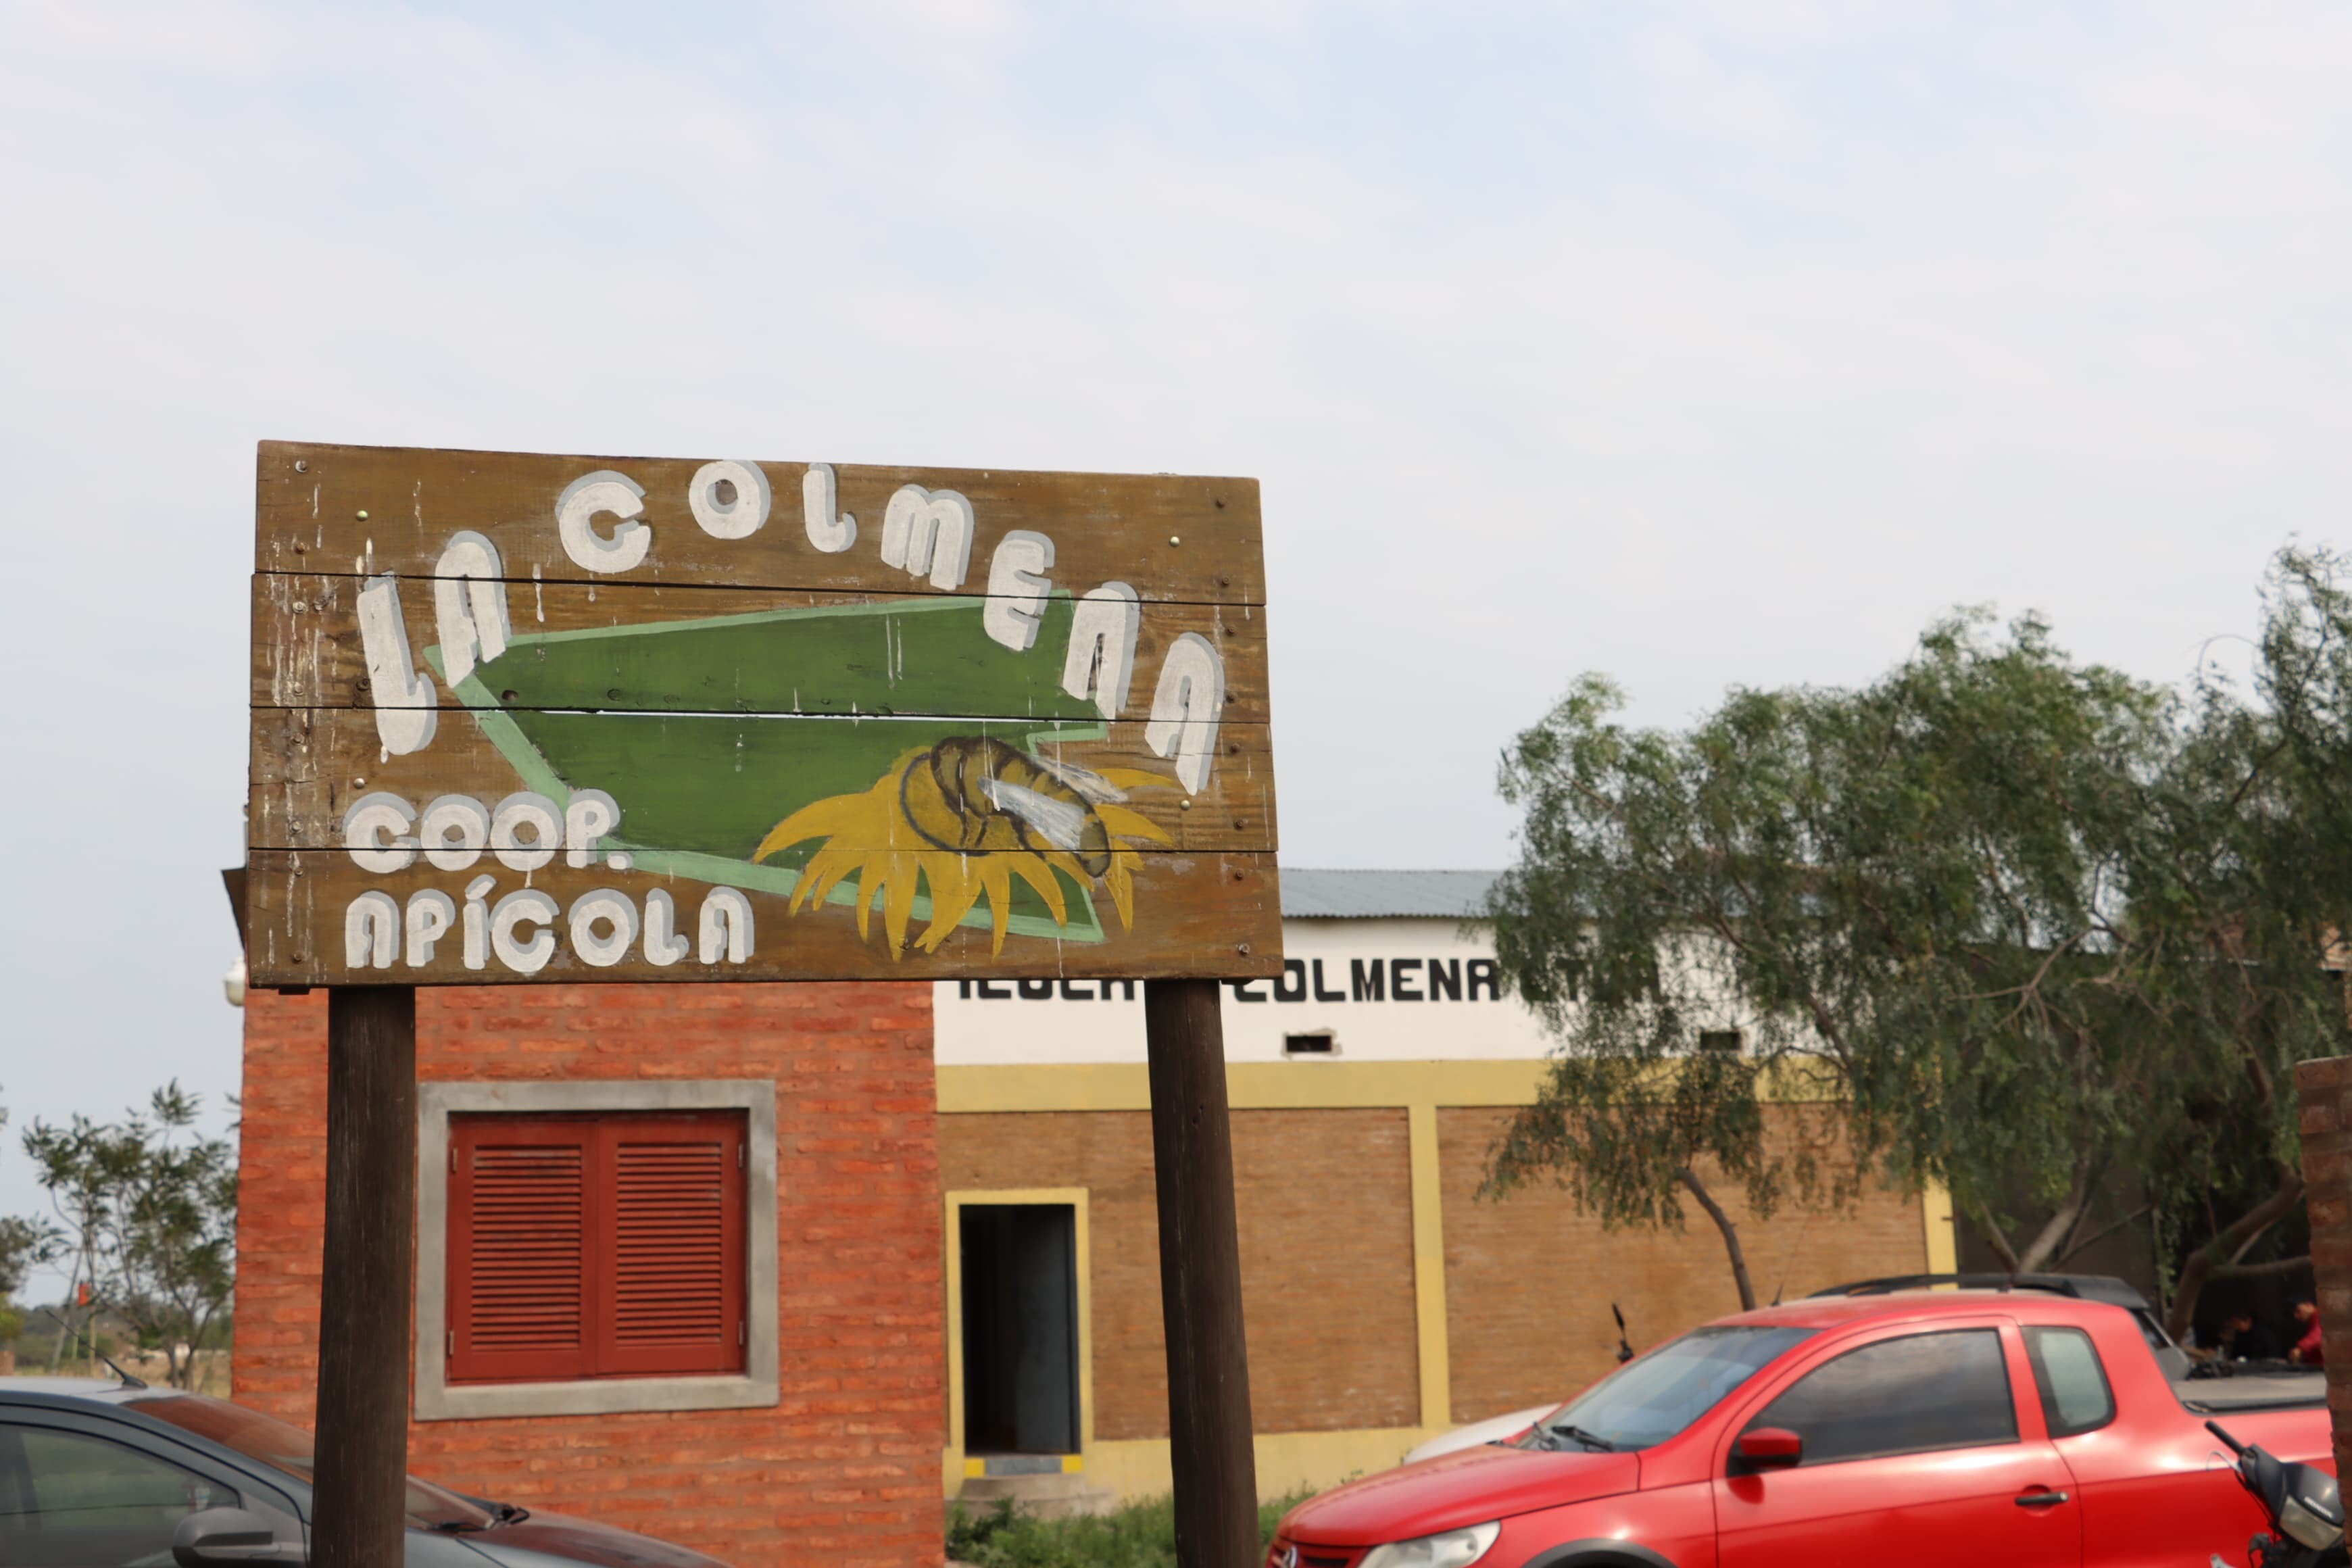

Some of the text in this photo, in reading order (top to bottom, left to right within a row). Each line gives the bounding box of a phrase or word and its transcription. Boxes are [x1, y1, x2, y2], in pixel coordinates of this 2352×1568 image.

[356, 460, 1225, 795] LA COLMENA
[342, 789, 633, 874] COOP.
[345, 874, 755, 973] APÍCOLA
